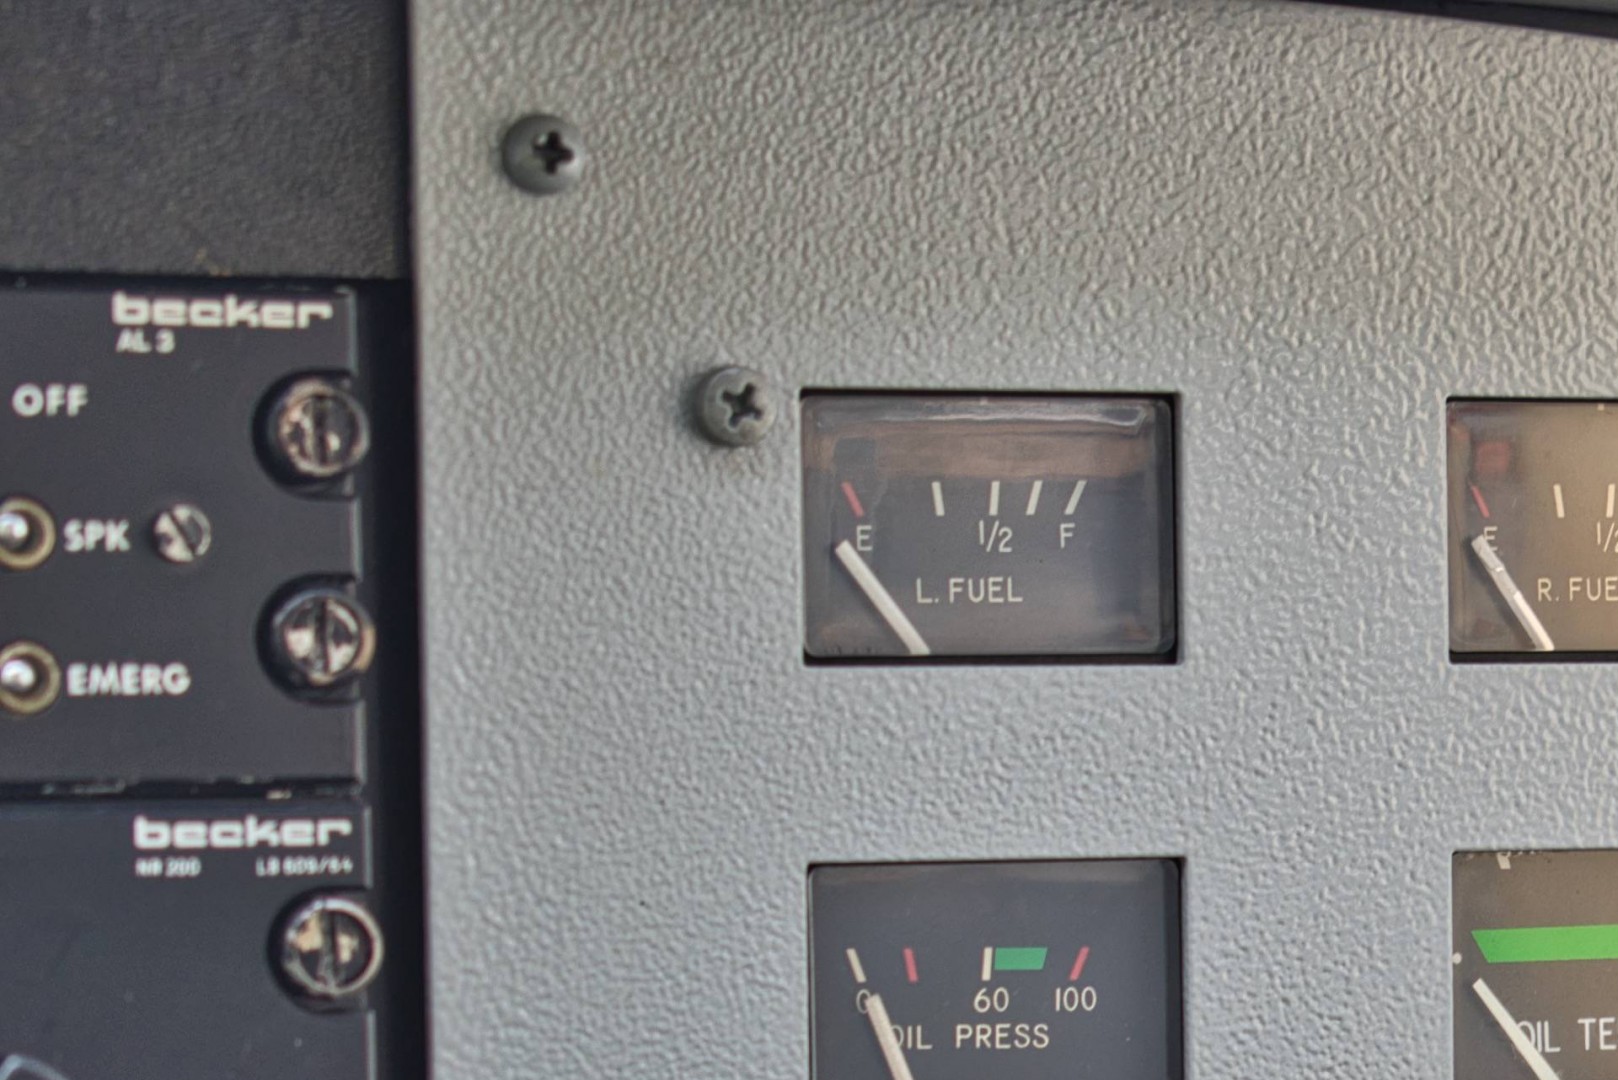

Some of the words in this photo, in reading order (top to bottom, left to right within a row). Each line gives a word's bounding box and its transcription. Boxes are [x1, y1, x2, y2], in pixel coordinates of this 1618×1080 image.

[112, 291, 334, 329] becker
[116, 329, 151, 353] AL
[156, 330, 176, 353] 3
[12, 384, 89, 417] OFF
[63, 519, 131, 552] SPK
[856, 525, 873, 552] E
[979, 520, 1014, 553] 1/2
[1059, 523, 1076, 549] F
[1483, 525, 1499, 552] E
[916, 578, 940, 604] L.
[949, 576, 1024, 603] FUEL
[1537, 577, 1560, 602] R.
[67, 662, 191, 696] EMERG
[133, 815, 353, 850] becker
[973, 987, 1010, 1013] 60
[1055, 986, 1098, 1012] 100
[955, 1023, 1050, 1050] PRESS
